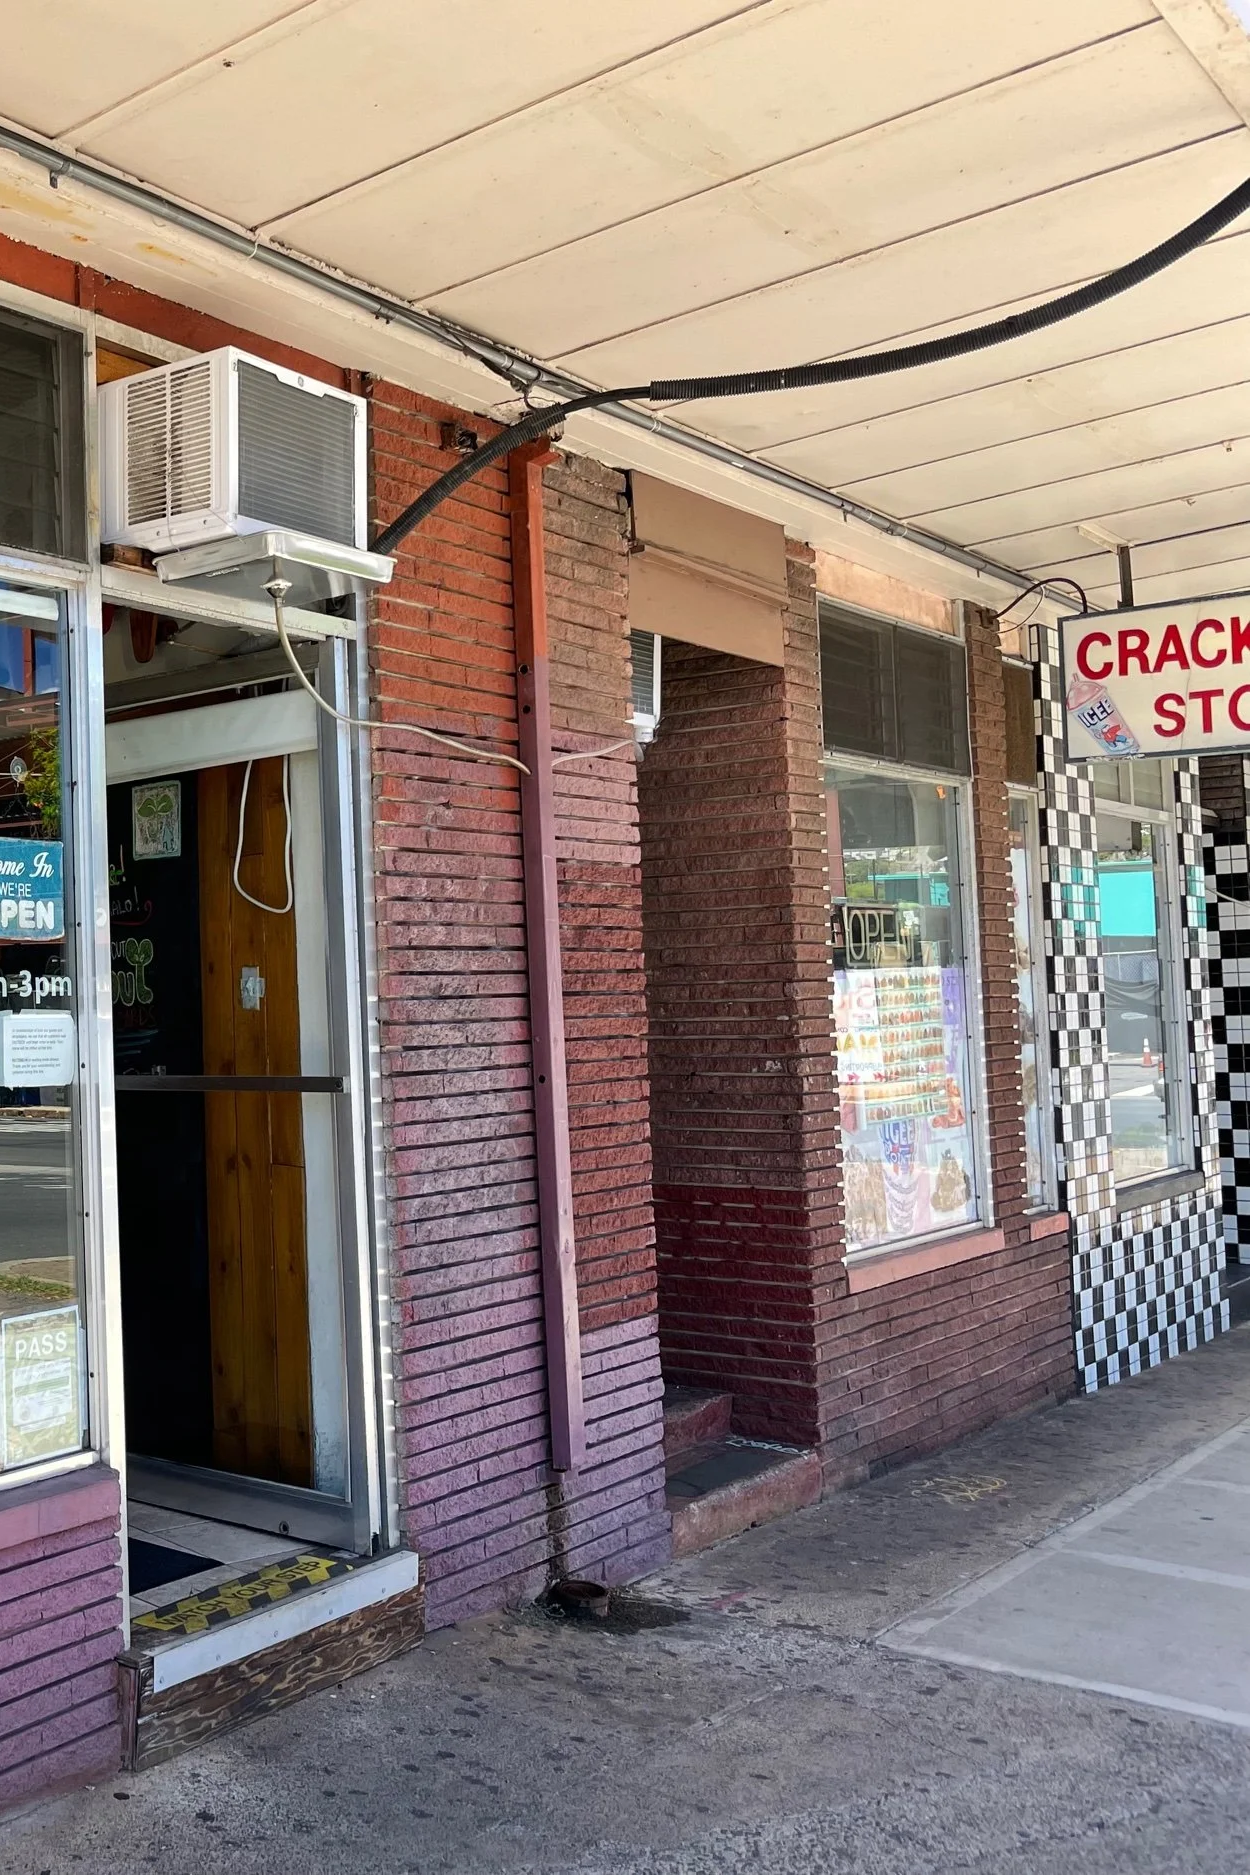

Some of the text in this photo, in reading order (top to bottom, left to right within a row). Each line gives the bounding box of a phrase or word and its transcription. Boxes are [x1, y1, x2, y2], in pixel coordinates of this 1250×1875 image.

[29, 852, 54, 878] In
[849, 909, 915, 962] OPEN
[15, 1330, 68, 1361] PASS
[156, 1559, 321, 1626] WATCH YOUR STEP
